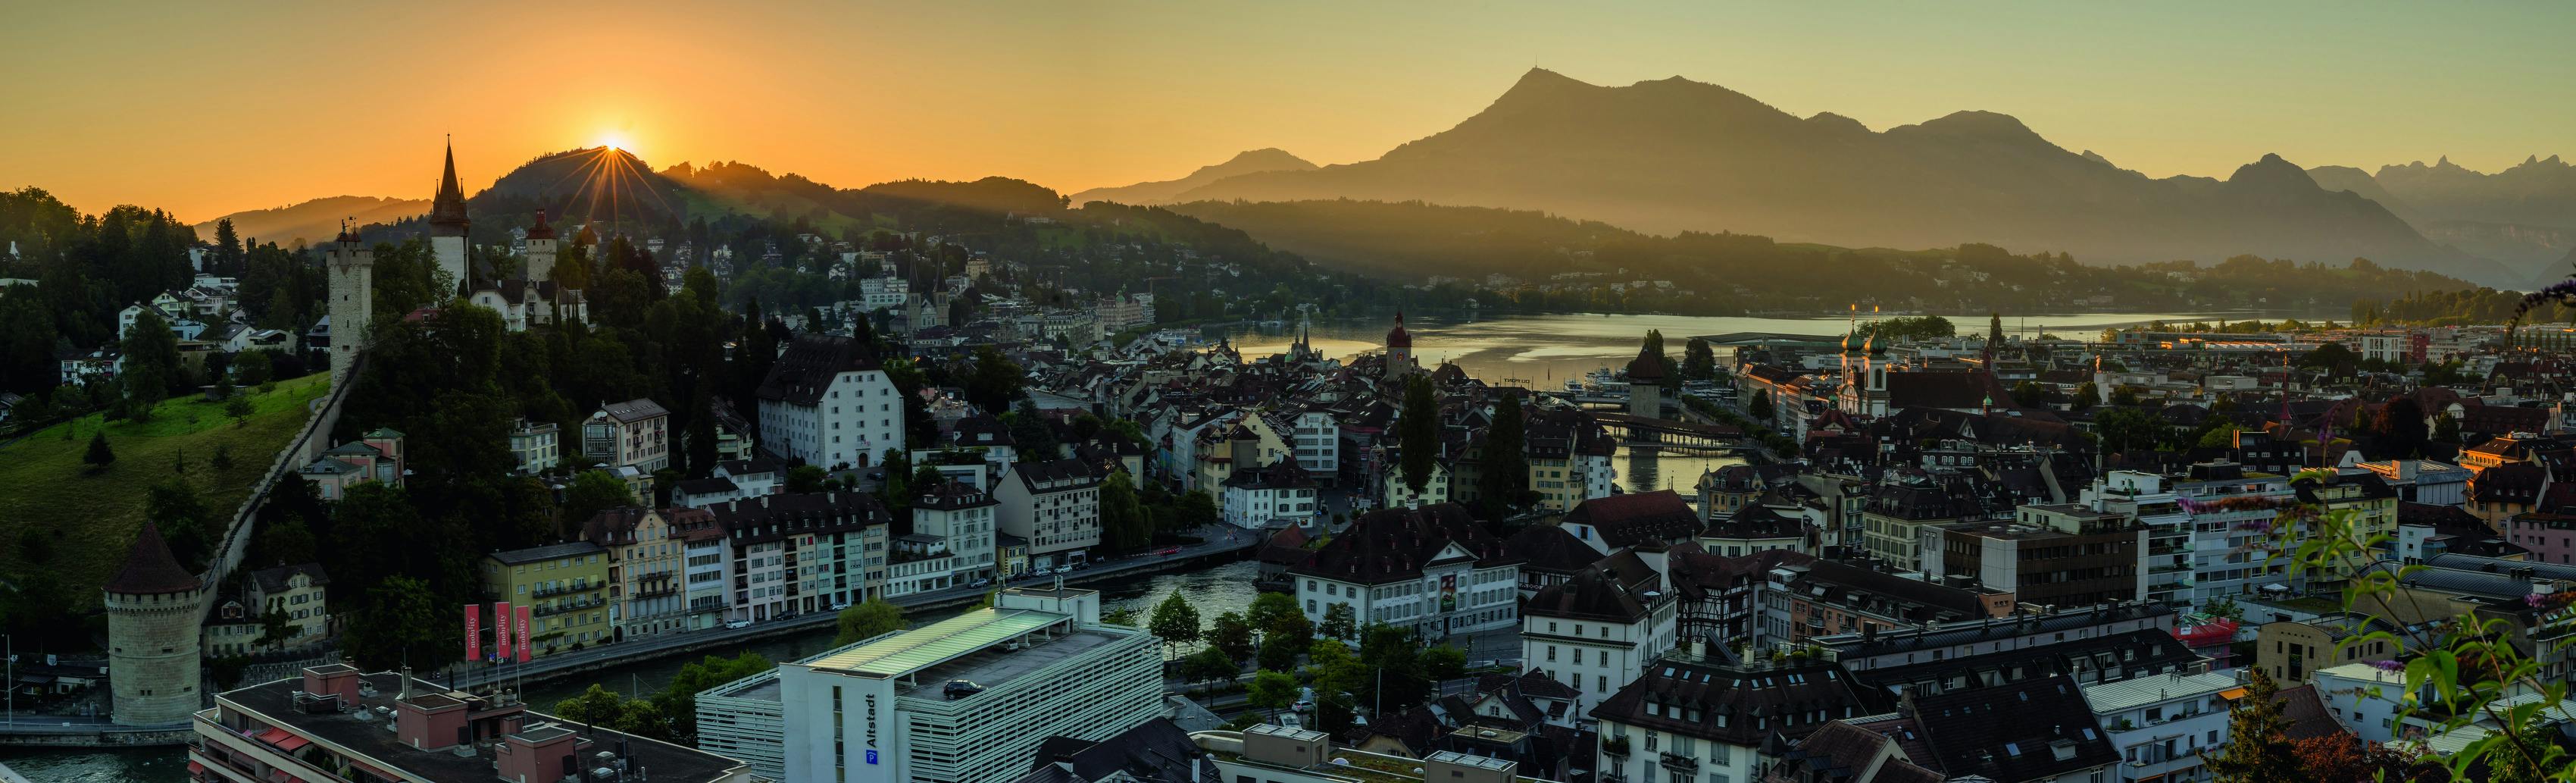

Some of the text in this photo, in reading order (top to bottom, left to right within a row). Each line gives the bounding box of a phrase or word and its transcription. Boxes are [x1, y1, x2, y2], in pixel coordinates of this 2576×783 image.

[467, 618, 476, 648] mobility
[497, 615, 507, 646] mobility
[517, 618, 526, 650] mobility
[865, 694, 876, 747] Altstadt
